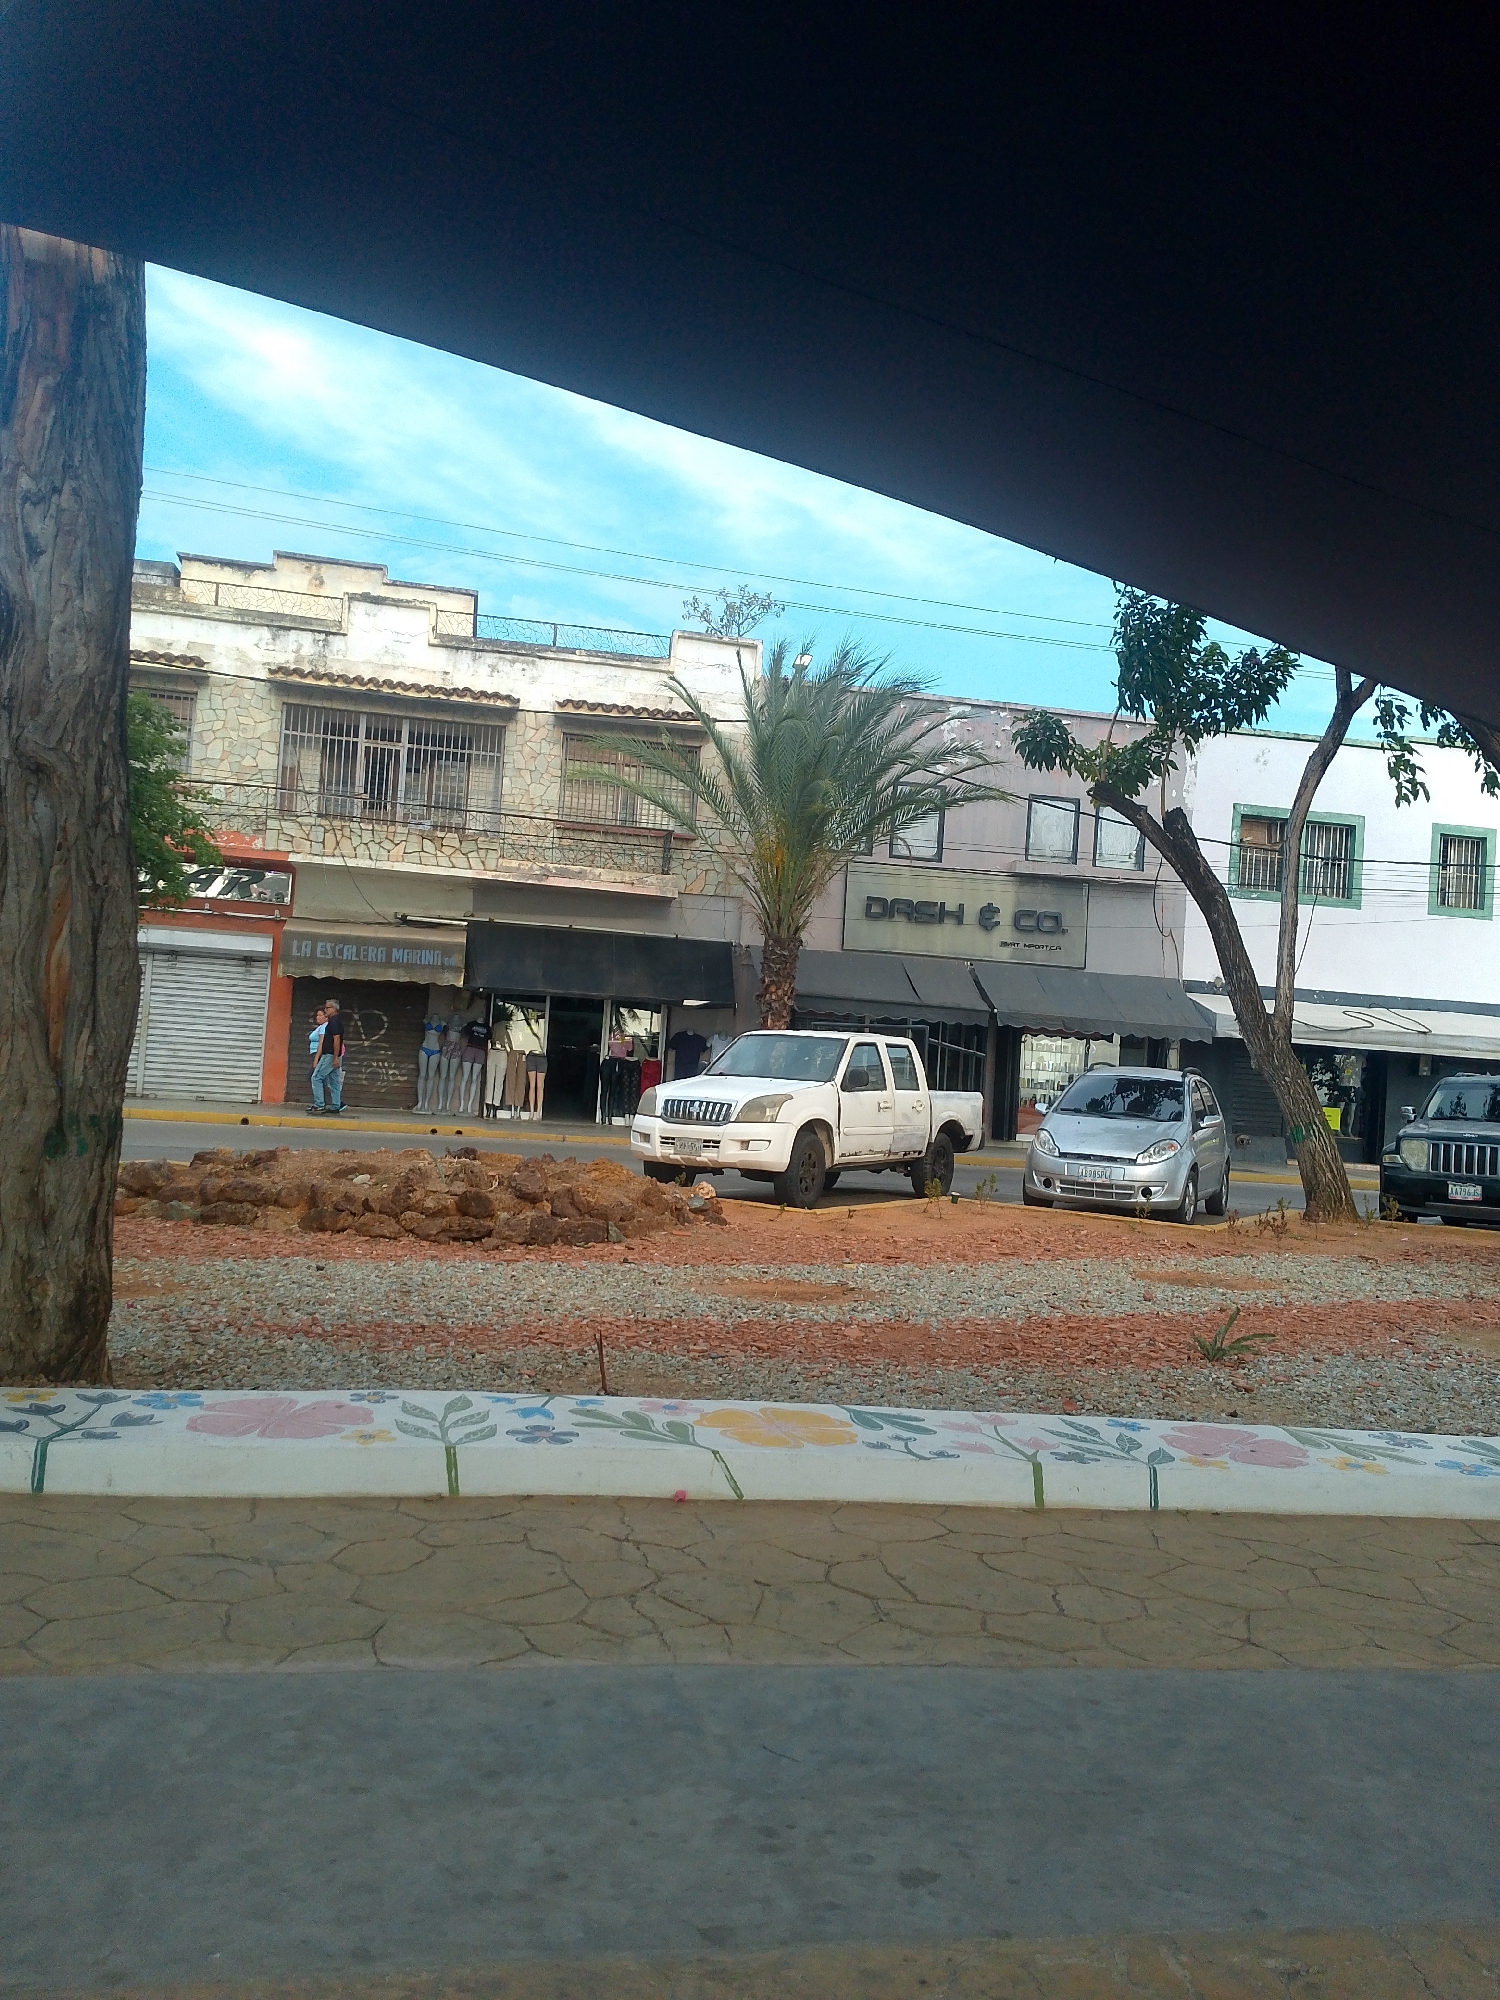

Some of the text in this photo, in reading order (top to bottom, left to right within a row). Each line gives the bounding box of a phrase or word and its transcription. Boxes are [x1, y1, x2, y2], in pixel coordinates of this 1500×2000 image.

[865, 895, 1069, 934] DASH & CO.
[292, 939, 312, 957] LA
[316, 942, 387, 963] ESCALERA
[391, 947, 442, 966] MARINA
